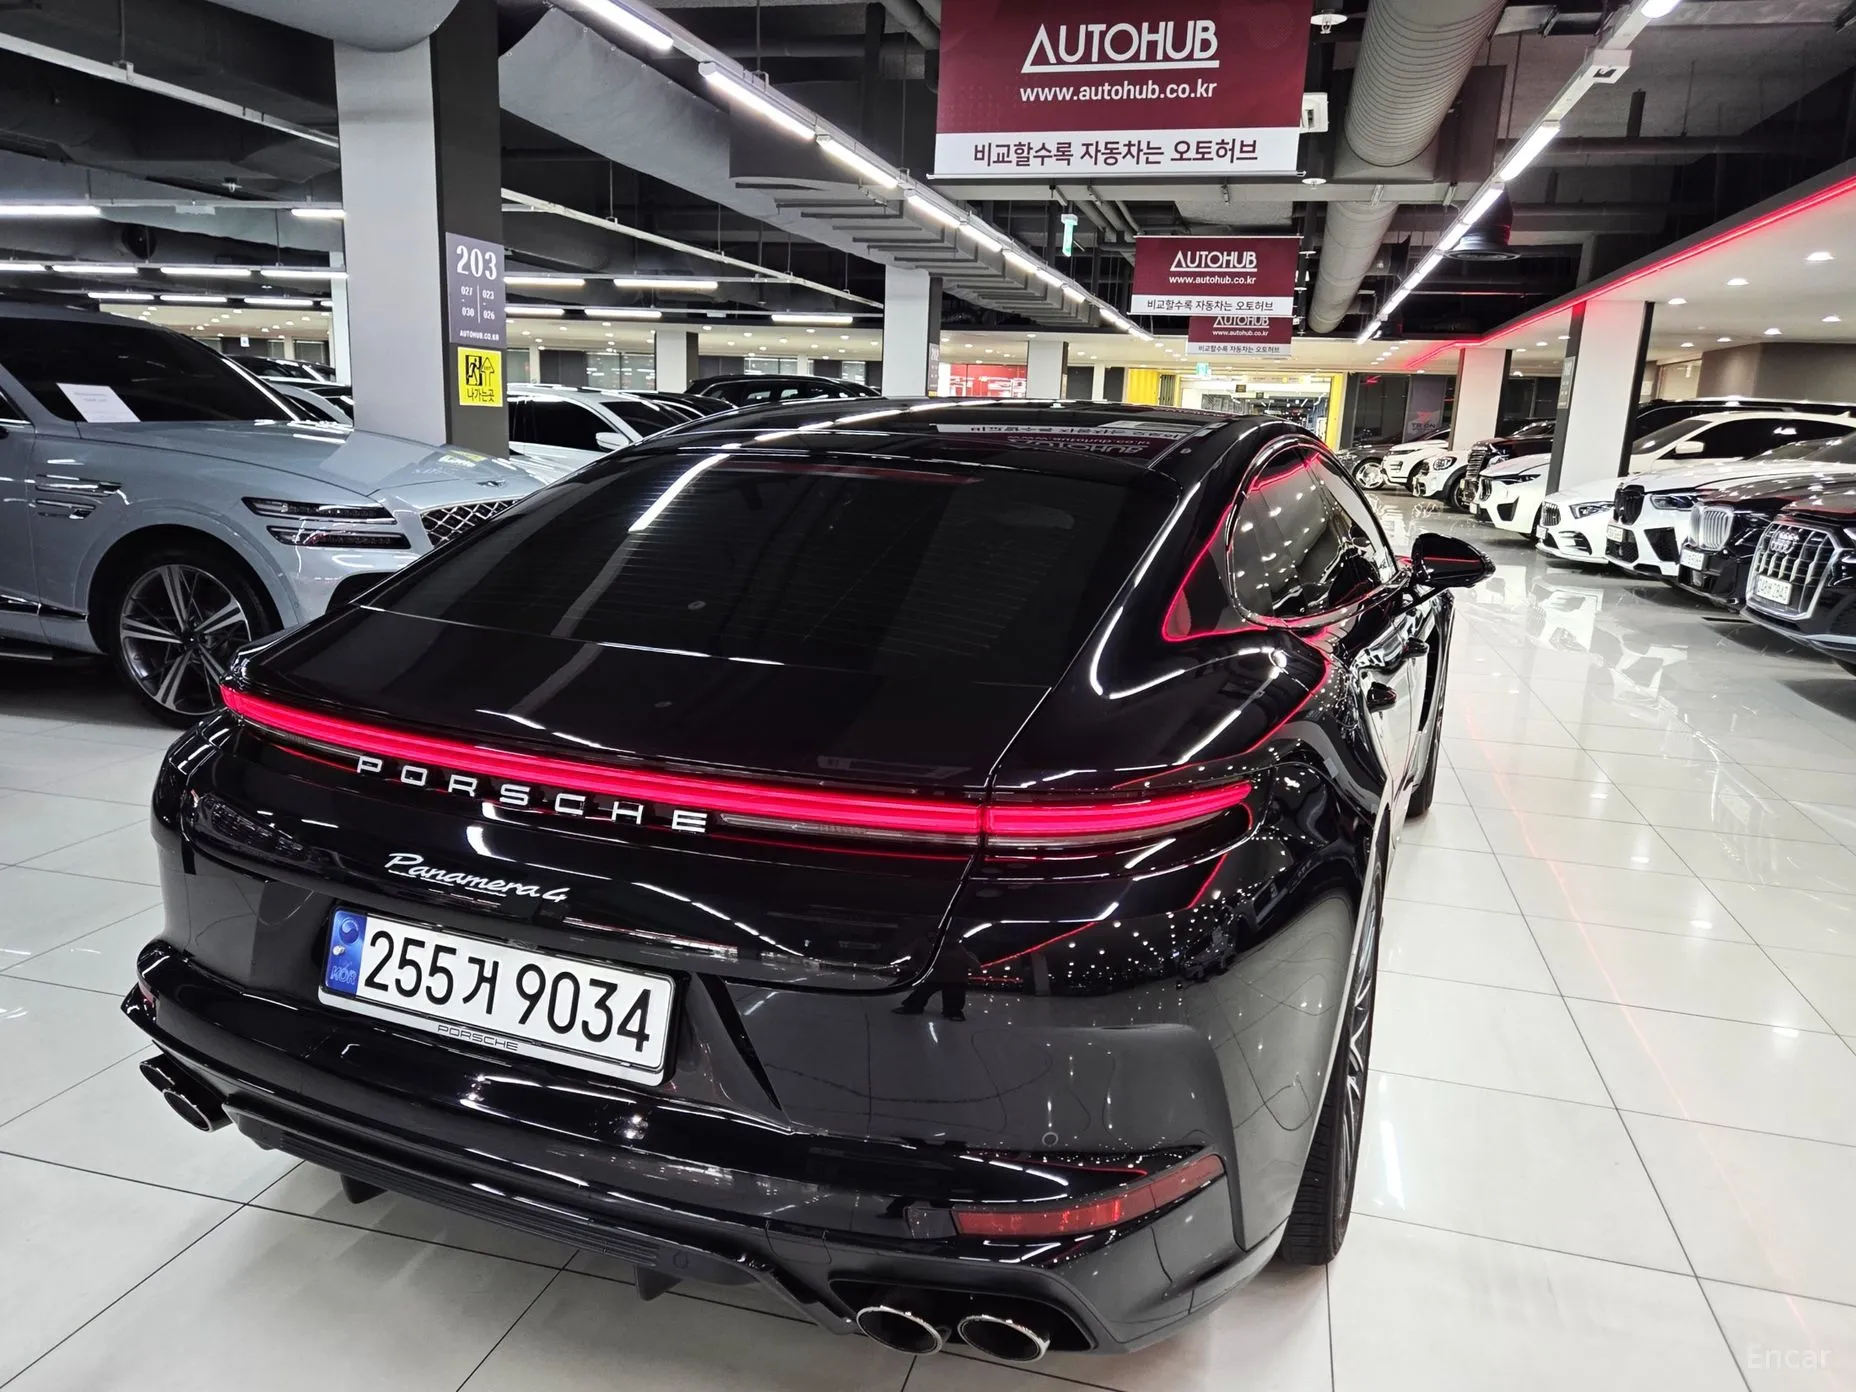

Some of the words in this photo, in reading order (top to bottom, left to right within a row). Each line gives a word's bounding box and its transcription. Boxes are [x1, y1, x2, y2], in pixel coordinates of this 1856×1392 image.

[1021, 20, 1220, 73] AUTOHUB
[1020, 79, 1217, 102] www.autohub.co.kr
[974, 141, 1074, 167] 비교할수록
[1080, 140, 1165, 166] 자동차는
[1170, 138, 1258, 164] 오토허브
[456, 245, 498, 280] 203
[1170, 251, 1258, 272] AUTOHUB
[1169, 275, 1256, 285] www.autohub.co.kr
[460, 286, 473, 296] 027
[482, 289, 495, 300] 023
[1147, 299, 1193, 311] 비교할수록
[1195, 300, 1233, 311] 자동차는
[1235, 300, 1274, 312] 오토허브
[1213, 315, 1270, 328] AUTOHUB
[459, 329, 499, 341] AUTOHUB.CO.KR
[466, 387, 495, 402] 나가는곳
[356, 756, 708, 833] PORSCHE
[364, 930, 500, 1015] 255거
[516, 963, 651, 1053] 9034
[437, 1024, 519, 1051] PORSCHE
